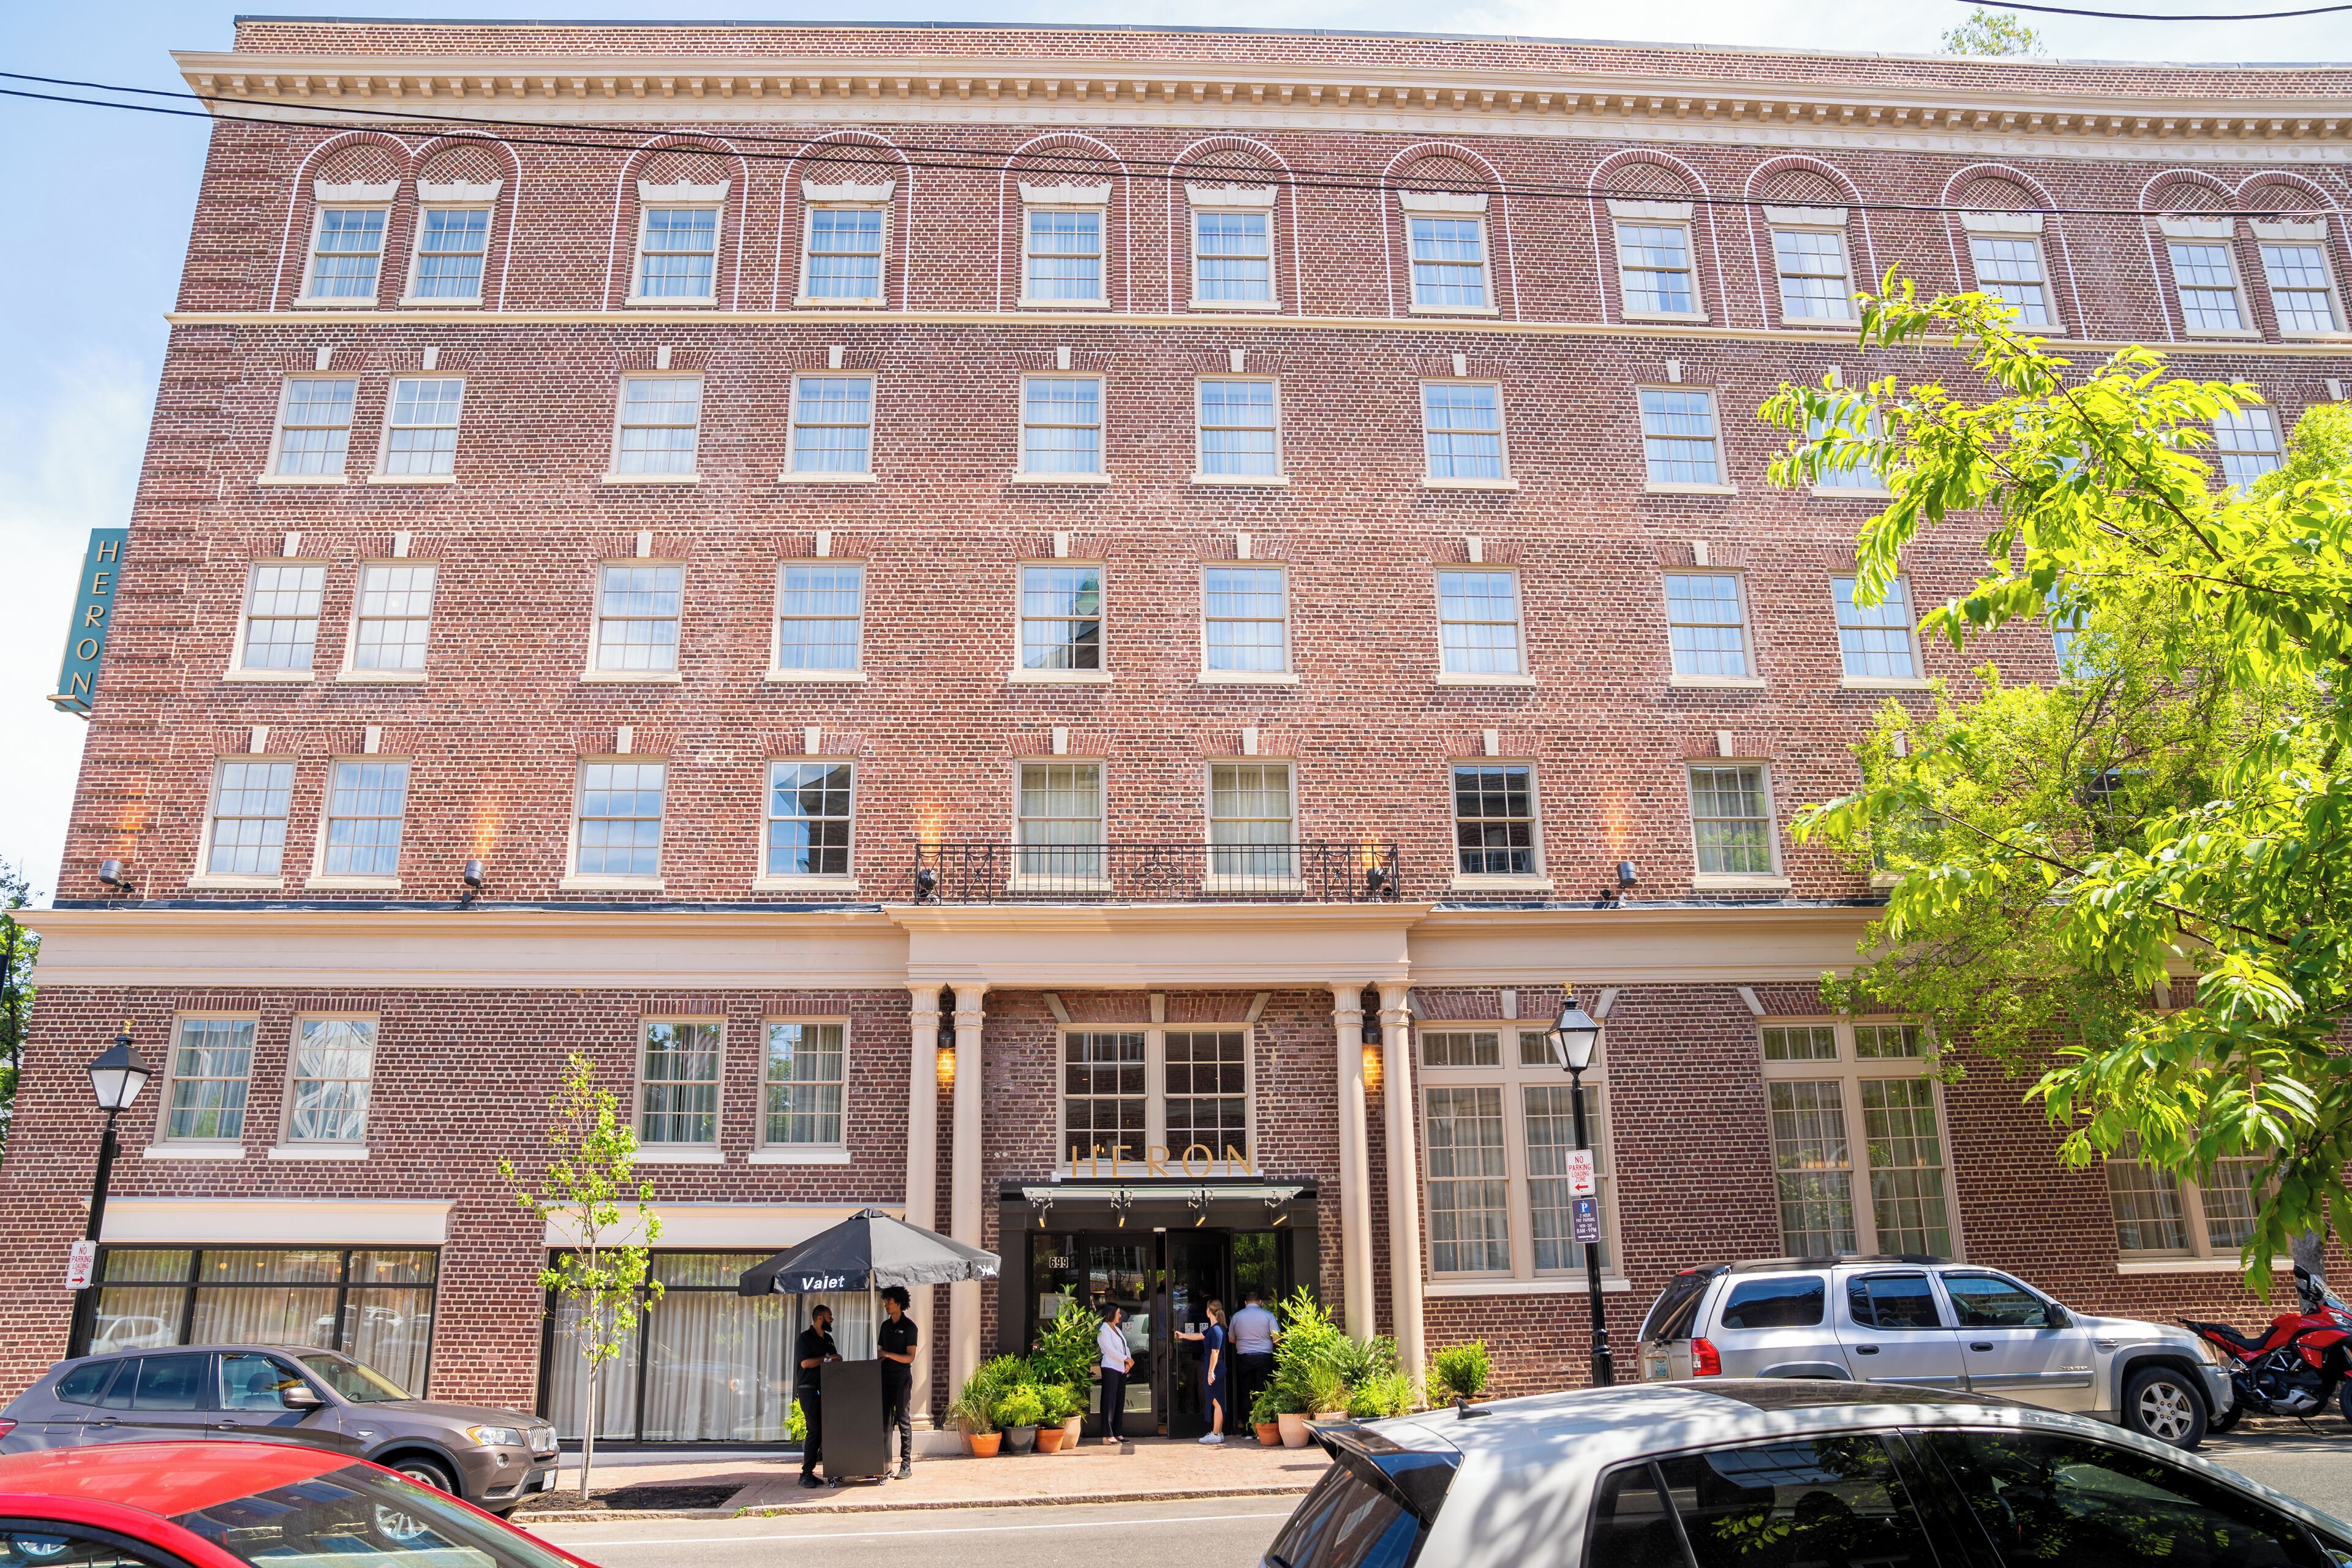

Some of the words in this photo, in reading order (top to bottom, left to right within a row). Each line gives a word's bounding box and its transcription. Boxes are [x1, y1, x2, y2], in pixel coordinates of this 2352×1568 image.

[70, 540, 119, 695] HERON
[1072, 1144, 1253, 1178] HERON
[1575, 1155, 1584, 1164] NO
[1581, 1202, 1588, 1213] P
[79, 1246, 88, 1255] NO
[1050, 1257, 1068, 1267] 699
